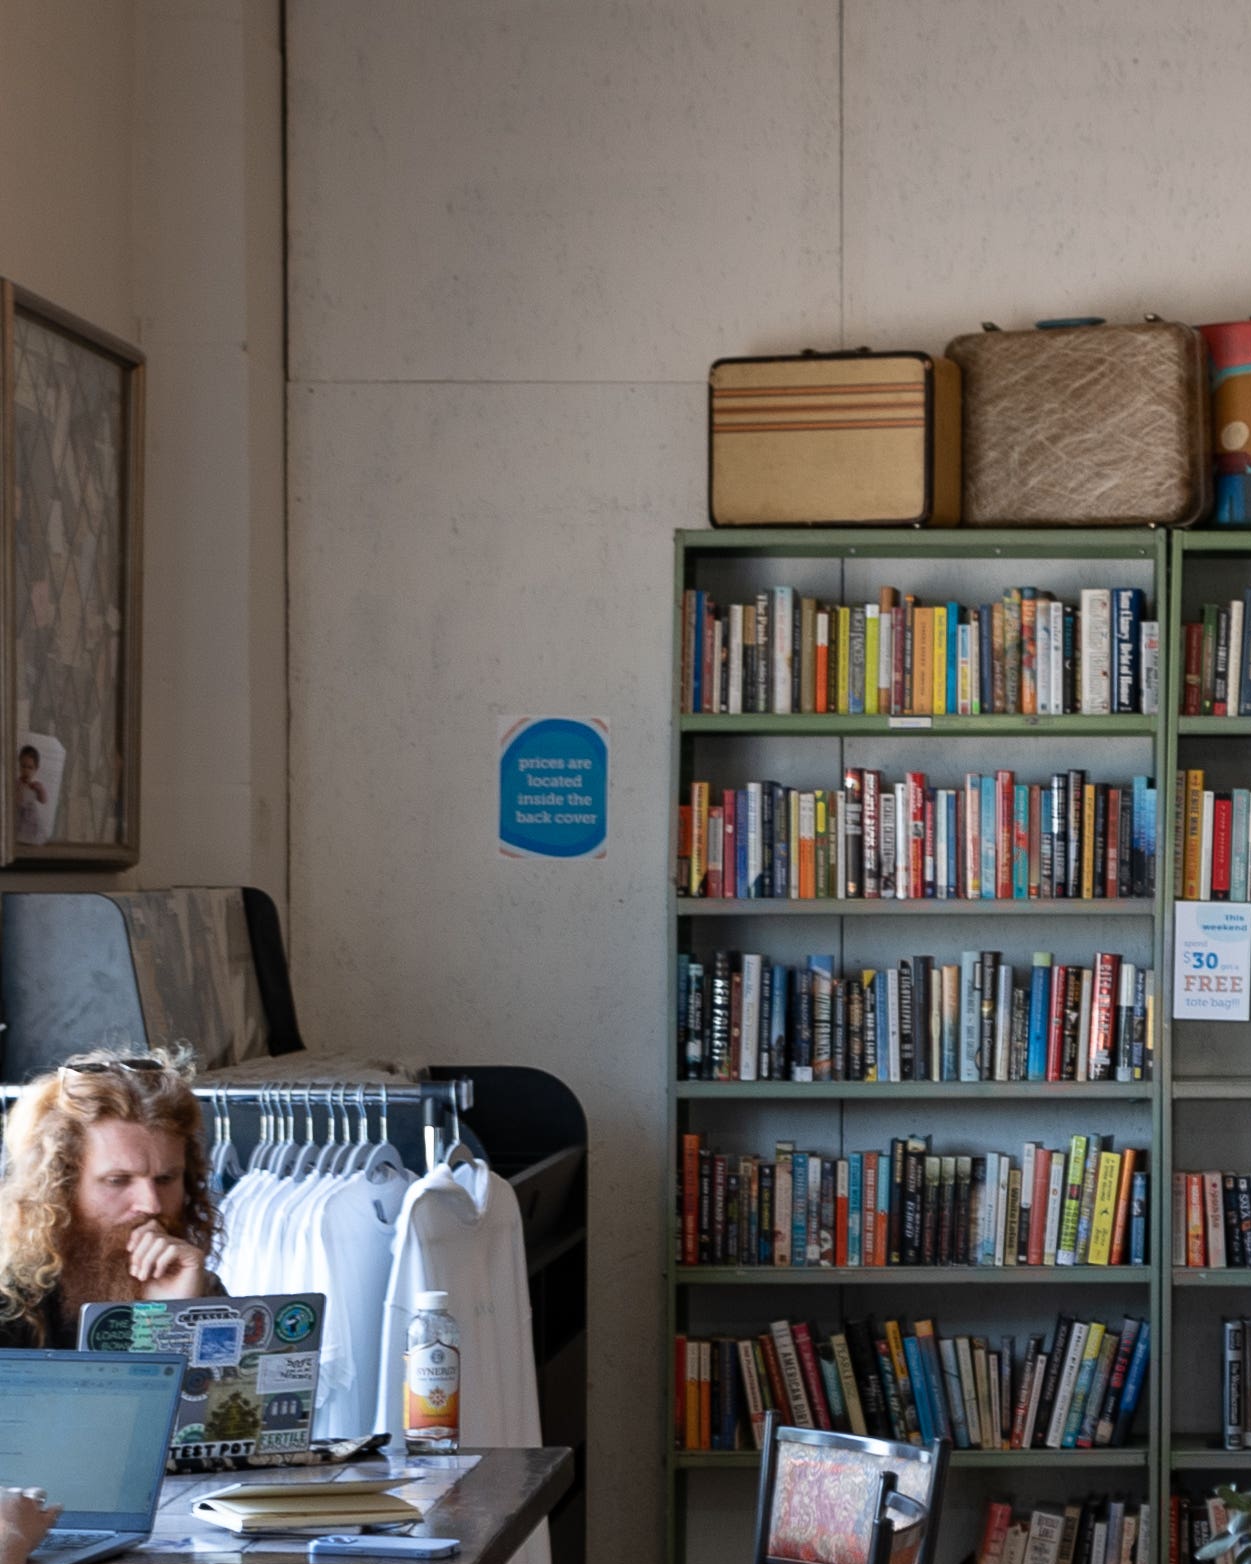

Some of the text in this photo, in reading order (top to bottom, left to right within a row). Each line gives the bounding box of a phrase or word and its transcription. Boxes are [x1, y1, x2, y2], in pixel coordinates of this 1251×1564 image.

[518, 758, 592, 772] prices are
[527, 774, 582, 787] located
[518, 793, 592, 805] inside the
[516, 811, 598, 824] back cover
[1183, 951, 1219, 969] $30
[1184, 975, 1244, 993] FREE
[1186, 998, 1209, 1007] tote
[416, 1367, 457, 1377] SYNERGY
[782, 1352, 800, 1400] AMERICAN
[262, 1431, 306, 1444] FERTILE
[169, 1442, 255, 1458] TEST POT
